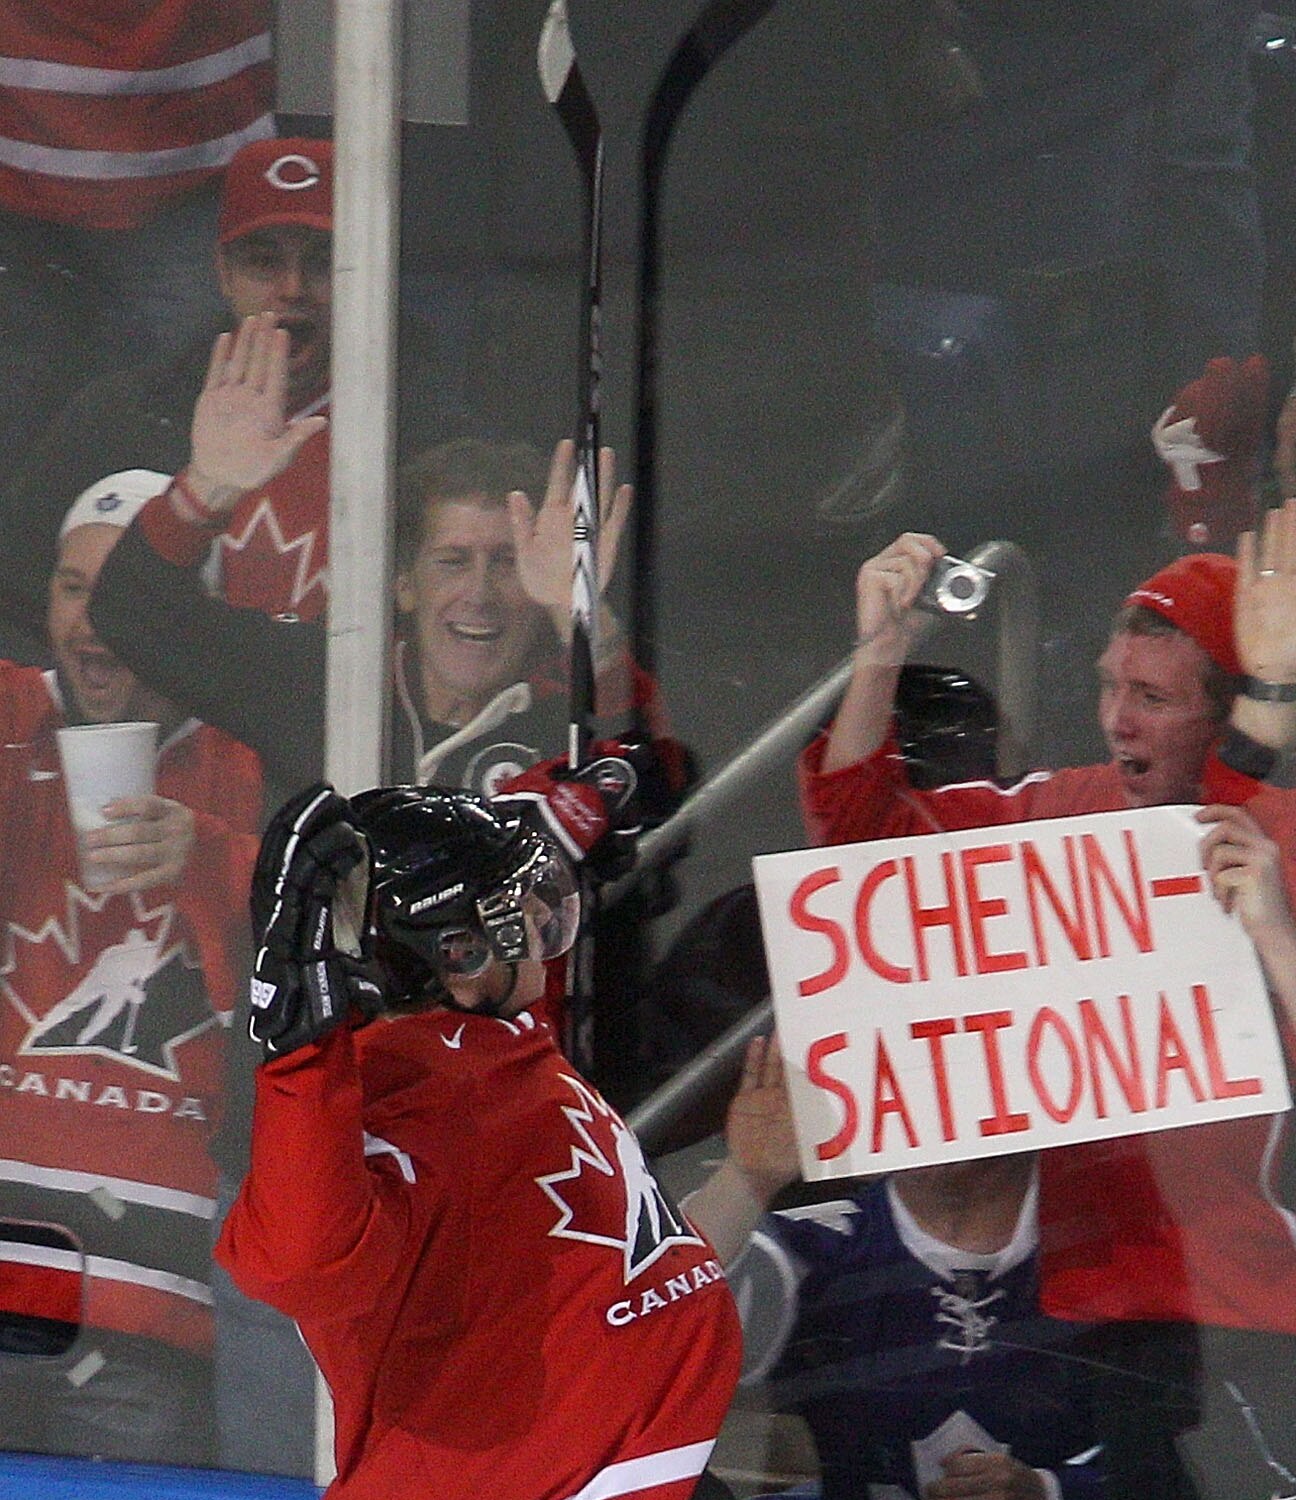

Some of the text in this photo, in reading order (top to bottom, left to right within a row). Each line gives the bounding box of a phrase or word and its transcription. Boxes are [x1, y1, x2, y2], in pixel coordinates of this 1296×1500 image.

[266, 154, 320, 190] C
[789, 830, 1204, 998] SCHENN-
[805, 984, 1263, 1161] SATIONAL
[606, 1259, 726, 1326] CANAD
